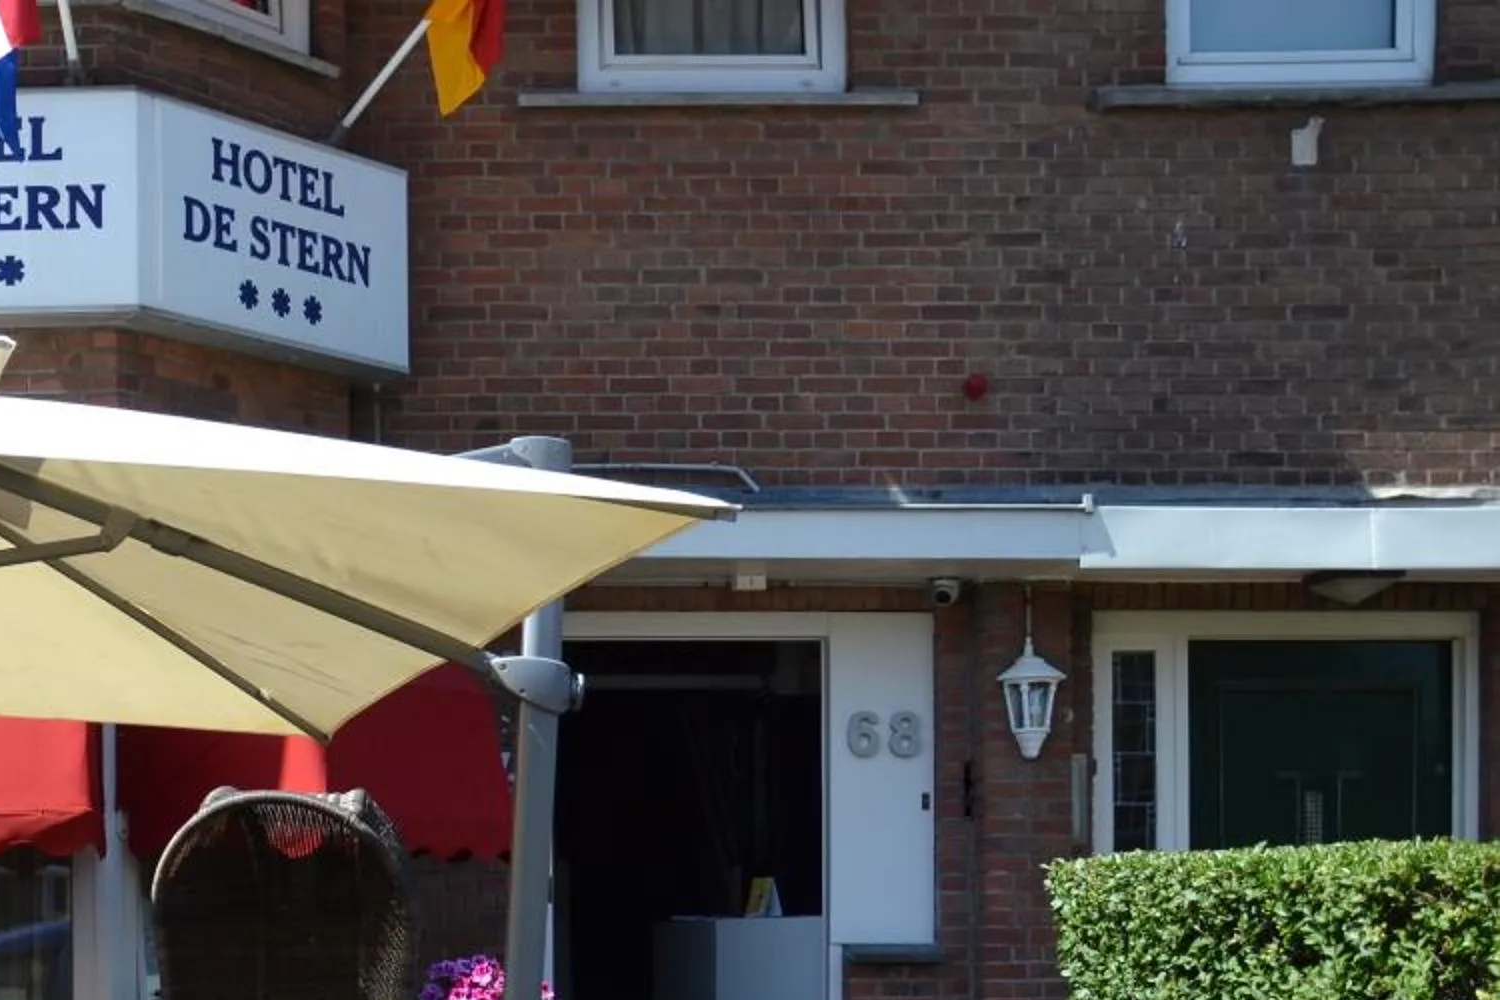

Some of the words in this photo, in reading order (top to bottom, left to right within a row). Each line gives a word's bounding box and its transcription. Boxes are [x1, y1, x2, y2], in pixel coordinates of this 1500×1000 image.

[211, 136, 345, 218] HOTEL
[183, 195, 238, 253] DE
[250, 214, 371, 288] STERN
[846, 710, 923, 760] 68
